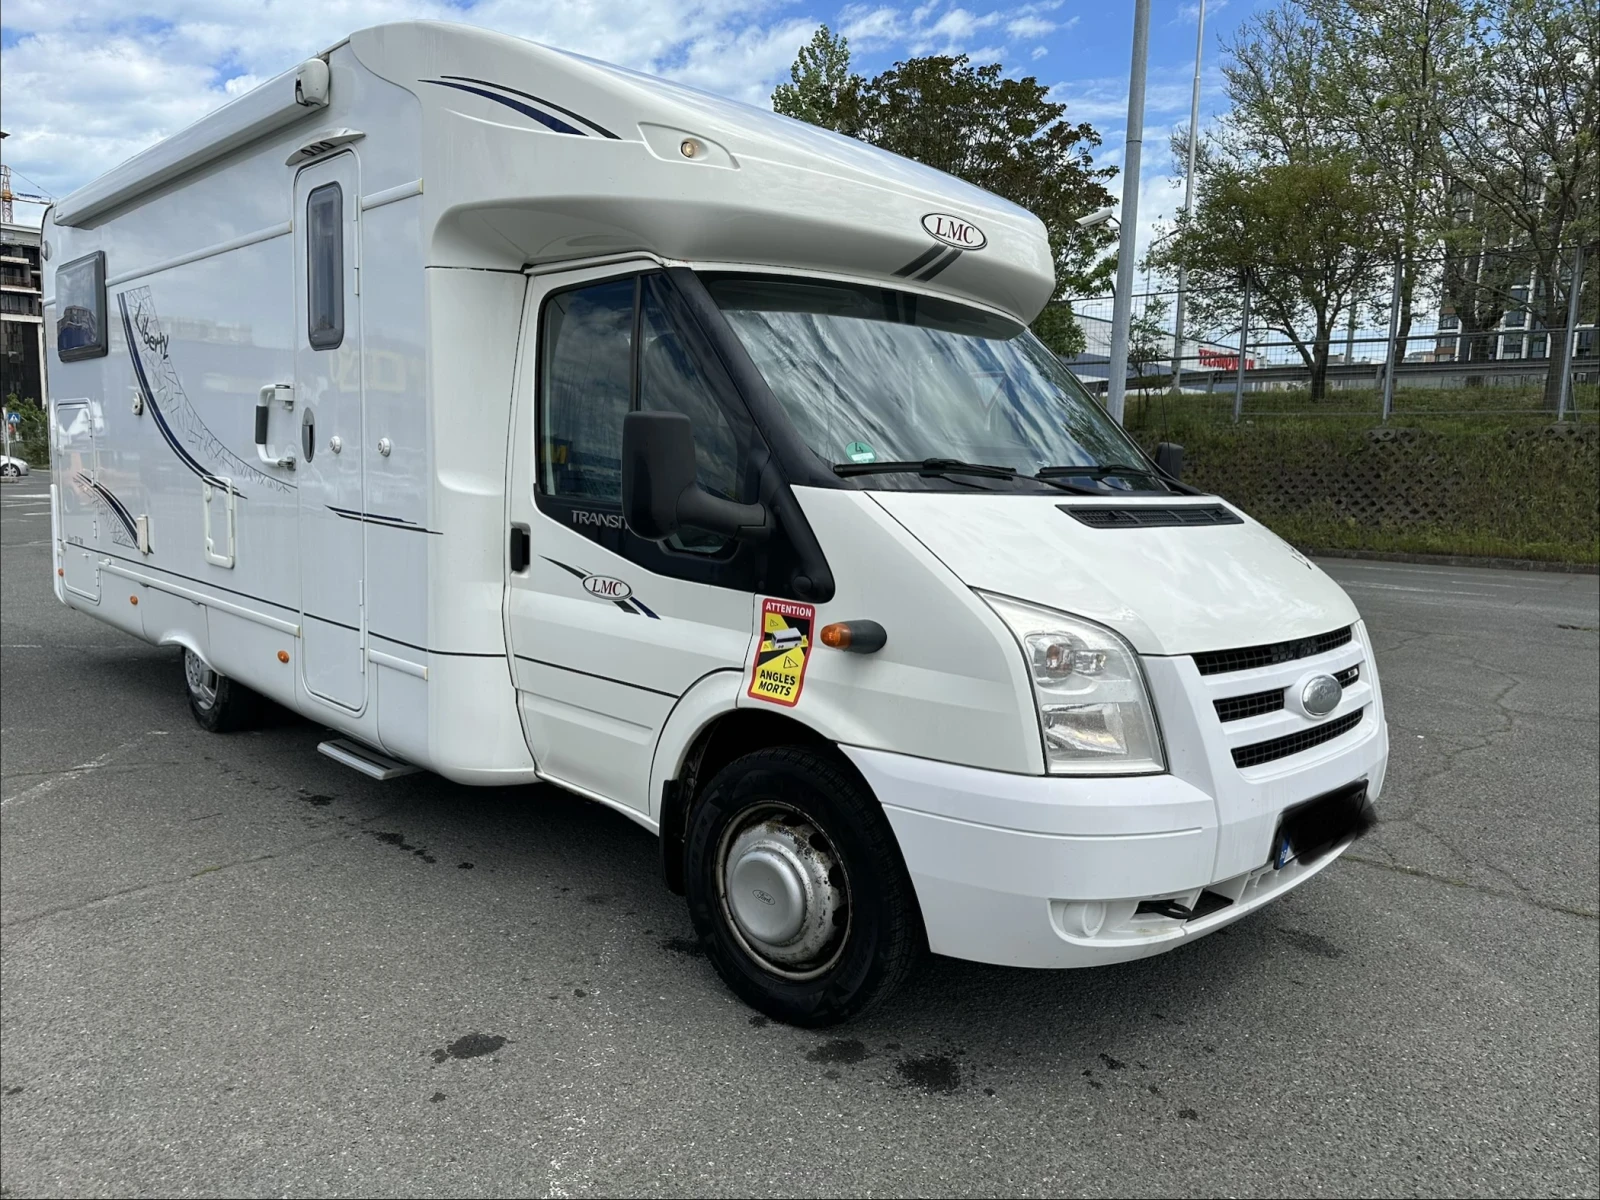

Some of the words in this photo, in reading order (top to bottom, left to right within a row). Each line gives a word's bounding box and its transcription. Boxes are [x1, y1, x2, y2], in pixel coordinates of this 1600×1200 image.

[935, 216, 975, 244] LMC
[592, 578, 622, 597] LMC
[766, 601, 812, 617] ATTENTION
[759, 669, 796, 686] ANGLES
[758, 680, 792, 697] MORTS
